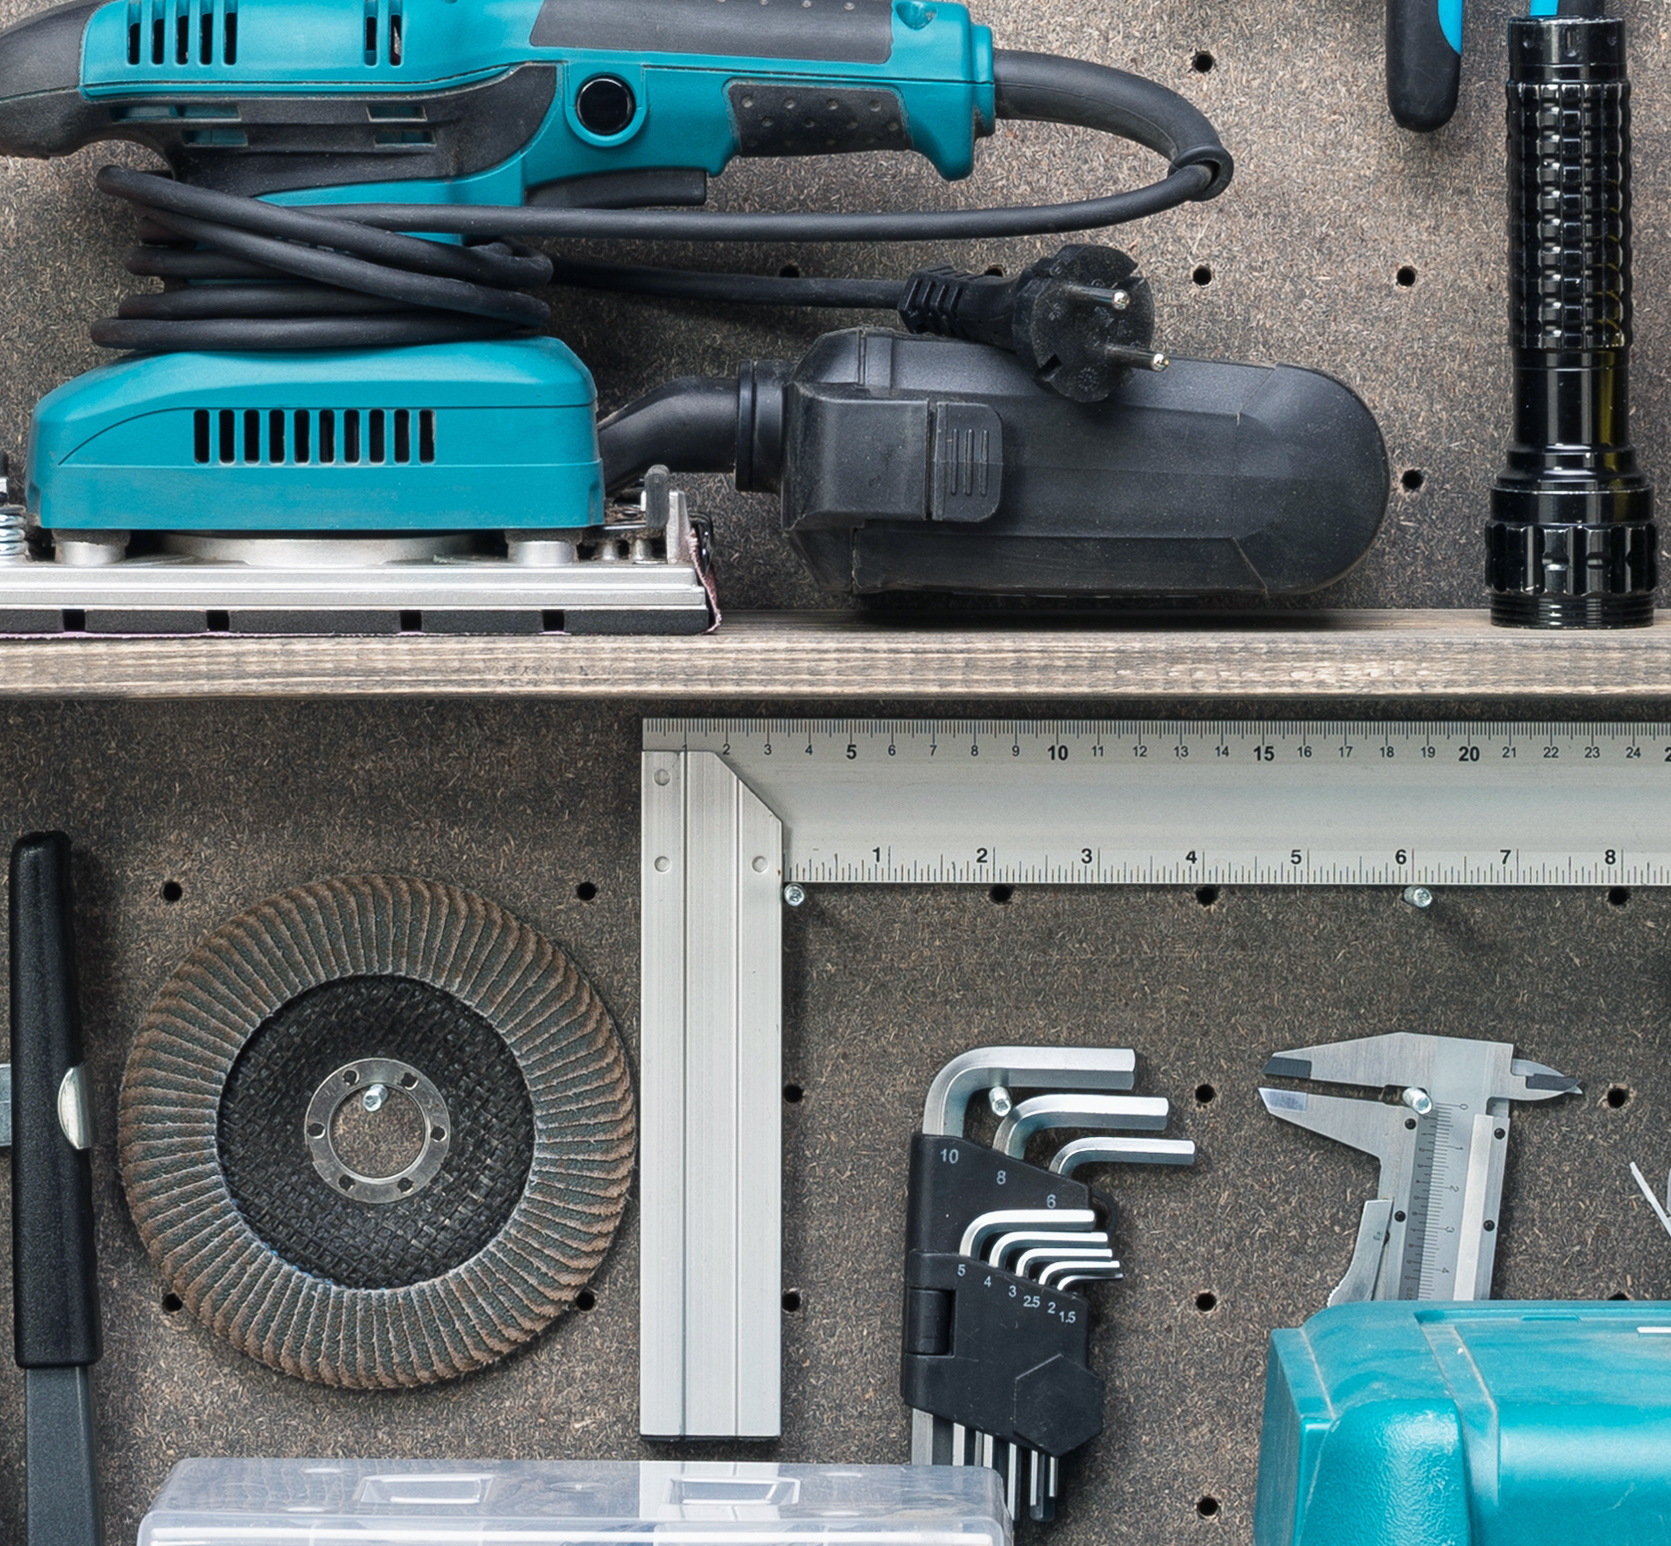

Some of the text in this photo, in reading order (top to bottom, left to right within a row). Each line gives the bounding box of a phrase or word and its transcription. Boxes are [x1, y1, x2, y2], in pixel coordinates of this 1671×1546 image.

[723, 744, 730, 755] 2
[763, 744, 773, 756] 3
[804, 745, 813, 756] 4
[845, 745, 858, 760] 5
[887, 745, 897, 756] 6
[929, 745, 938, 757] 7
[970, 745, 979, 757] 8
[1011, 745, 1020, 757] 9
[1047, 745, 1069, 761] 10
[1091, 746, 1104, 757] 11
[1132, 746, 1148, 757] 12
[1173, 746, 1189, 757] 13
[1214, 746, 1230, 757] 14
[1253, 746, 1275, 762] 15
[1297, 746, 1313, 758] 16
[1338, 746, 1354, 758] 17
[1379, 747, 1395, 758] 18
[1420, 747, 1436, 758] 19
[1458, 747, 1481, 762] 20
[1501, 747, 1517, 758] 21
[1543, 747, 1559, 759] 22
[1584, 747, 1601, 759] 23
[1625, 747, 1642, 759] 24
[872, 847, 881, 862] 1
[975, 848, 988, 863] 2
[1080, 848, 1093, 864] 3
[1185, 849, 1198, 864] 4
[1290, 849, 1303, 864] 5
[1394, 849, 1407, 865] 6
[1499, 850, 1512, 864] 7
[1604, 849, 1617, 865] 8
[940, 1148, 1057, 1209] 10 8 6
[1449, 1185, 1459, 1193] 2
[957, 1264, 966, 1277] 5
[983, 1276, 992, 1288] 4
[1008, 1286, 1017, 1298] 3
[1047, 1302, 1056, 1314] 2
[1059, 1311, 1076, 1324] 1.5
